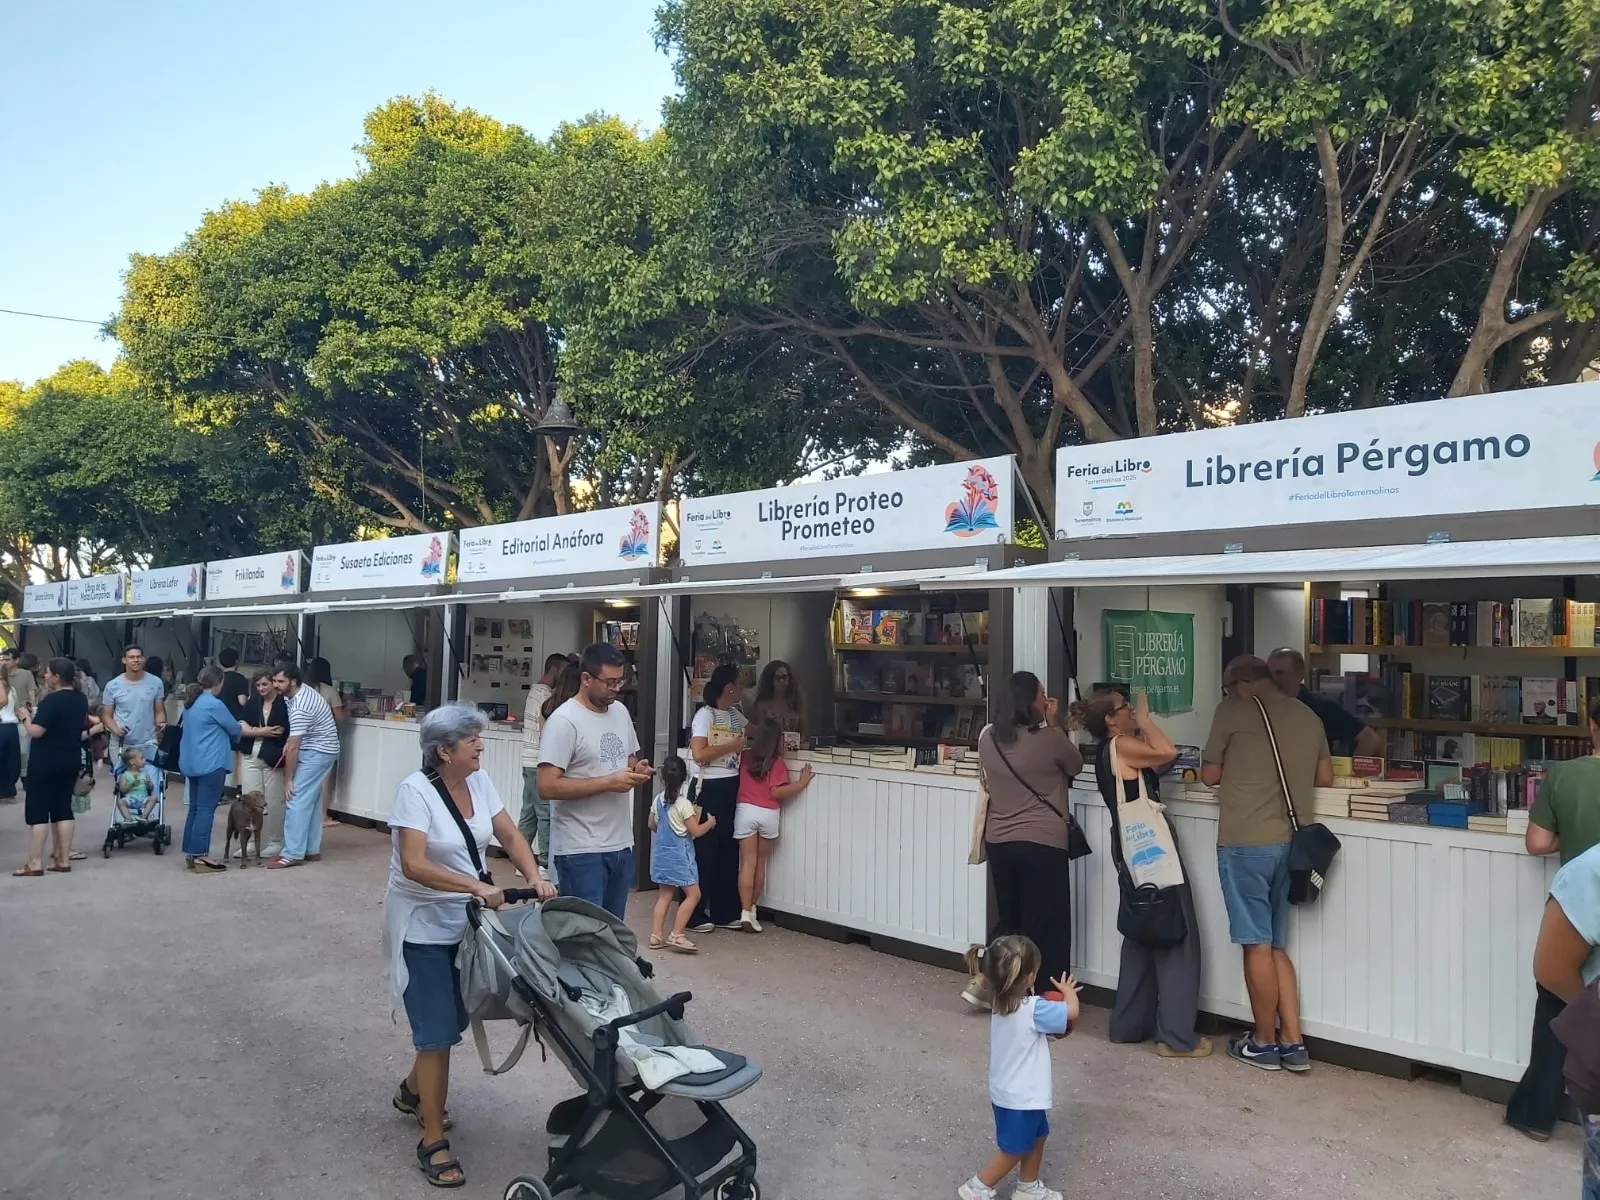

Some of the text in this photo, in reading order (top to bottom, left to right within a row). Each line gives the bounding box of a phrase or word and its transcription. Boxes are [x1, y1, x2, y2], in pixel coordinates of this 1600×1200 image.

[1067, 458, 1152, 478] Feria del Libro
[1185, 433, 1531, 488] Librería Pérgamo
[1085, 474, 1137, 486] Torremolinos 2025
[1288, 486, 1400, 501] #FeriadelLibroTorremolinos
[686, 512, 704, 522] Feria
[712, 509, 732, 520] Libro
[758, 491, 904, 522] Librería Proteo
[781, 517, 875, 541] Prometeo
[502, 528, 604, 556] Editorial Anáfora
[340, 551, 413, 570] Susaeta Ediciones
[235, 566, 265, 581] Frikilandia
[1137, 629, 1185, 652] LIBRERÍA
[1135, 652, 1186, 676] PÉRGAMO
[1129, 685, 1180, 696] breriapergamo.es
[1125, 822, 1146, 834] Feria
[1133, 829, 1157, 842] Libro
